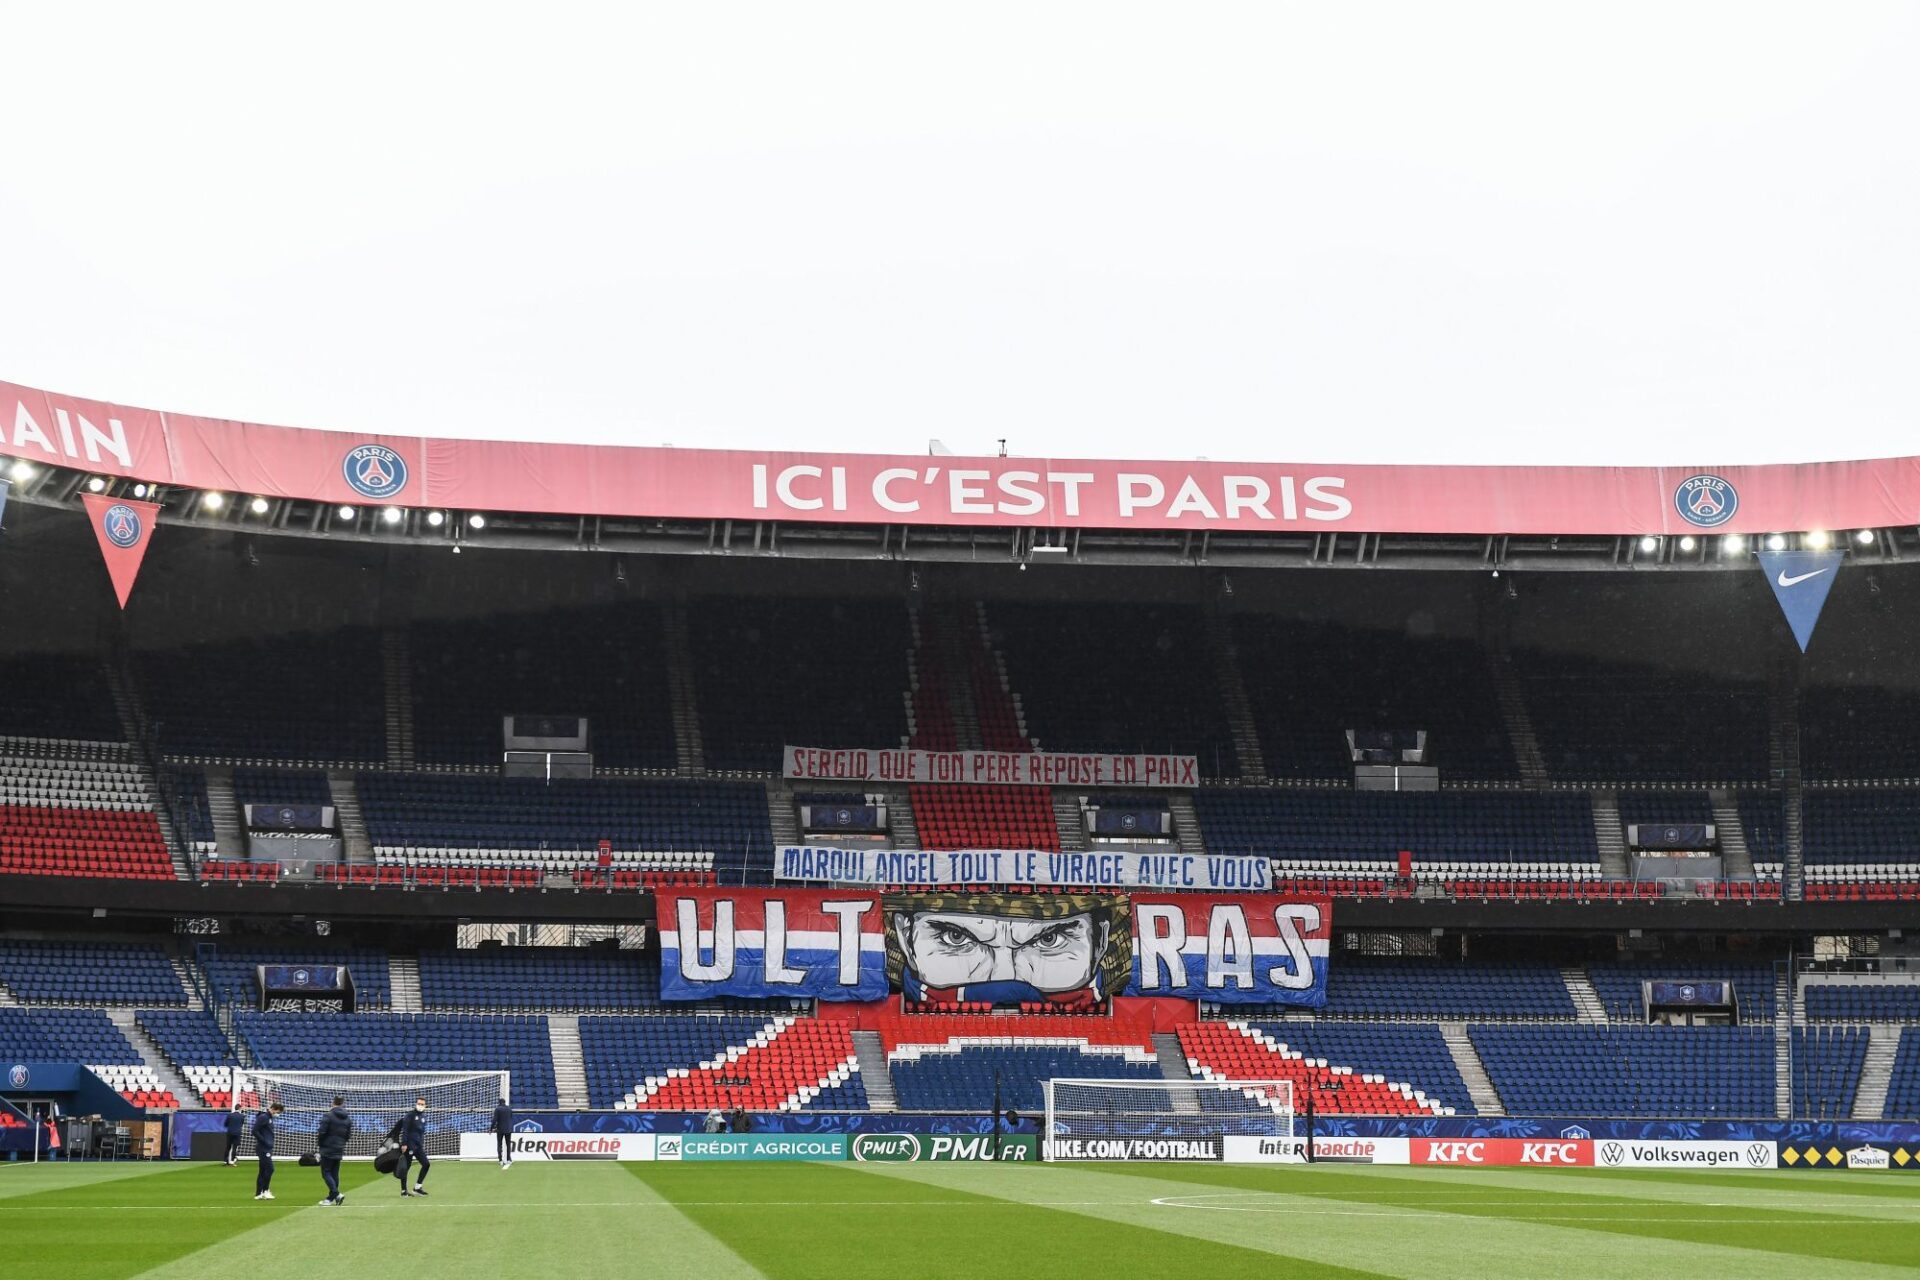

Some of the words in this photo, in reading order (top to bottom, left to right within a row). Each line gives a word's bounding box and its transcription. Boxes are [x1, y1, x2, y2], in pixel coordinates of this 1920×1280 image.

[0, 399, 133, 468] AIN
[352, 448, 394, 462] PARIS
[752, 464, 848, 512] ICI
[872, 467, 1094, 516] C'EST
[1117, 473, 1353, 521] PARIS
[1685, 478, 1725, 491] PARIS
[879, 752, 917, 779] QUE
[926, 753, 964, 781] TON
[973, 754, 1021, 782] PERE
[1030, 755, 1103, 785] REPOSE
[1113, 756, 1136, 784] EN
[1145, 757, 1195, 785] PAIX
[876, 853, 938, 883] ANGEL
[949, 853, 1002, 882] TOUT
[1015, 853, 1036, 881] LE
[1049, 853, 1124, 884] VIRAGE
[1138, 856, 1194, 886] AVEC
[1207, 858, 1266, 887] VOUS
[676, 898, 875, 986] ULT
[1136, 903, 1320, 990] RAS
[685, 1141, 749, 1155] CRÉDIT
[753, 1142, 842, 1155] AGRICOLE
[862, 1141, 897, 1155] PMU
[1427, 1142, 1485, 1162] KFC
[1520, 1143, 1577, 1163] KFC
[1631, 1146, 1739, 1165] Volkswagen
[1851, 1154, 1885, 1166] Pasquier
